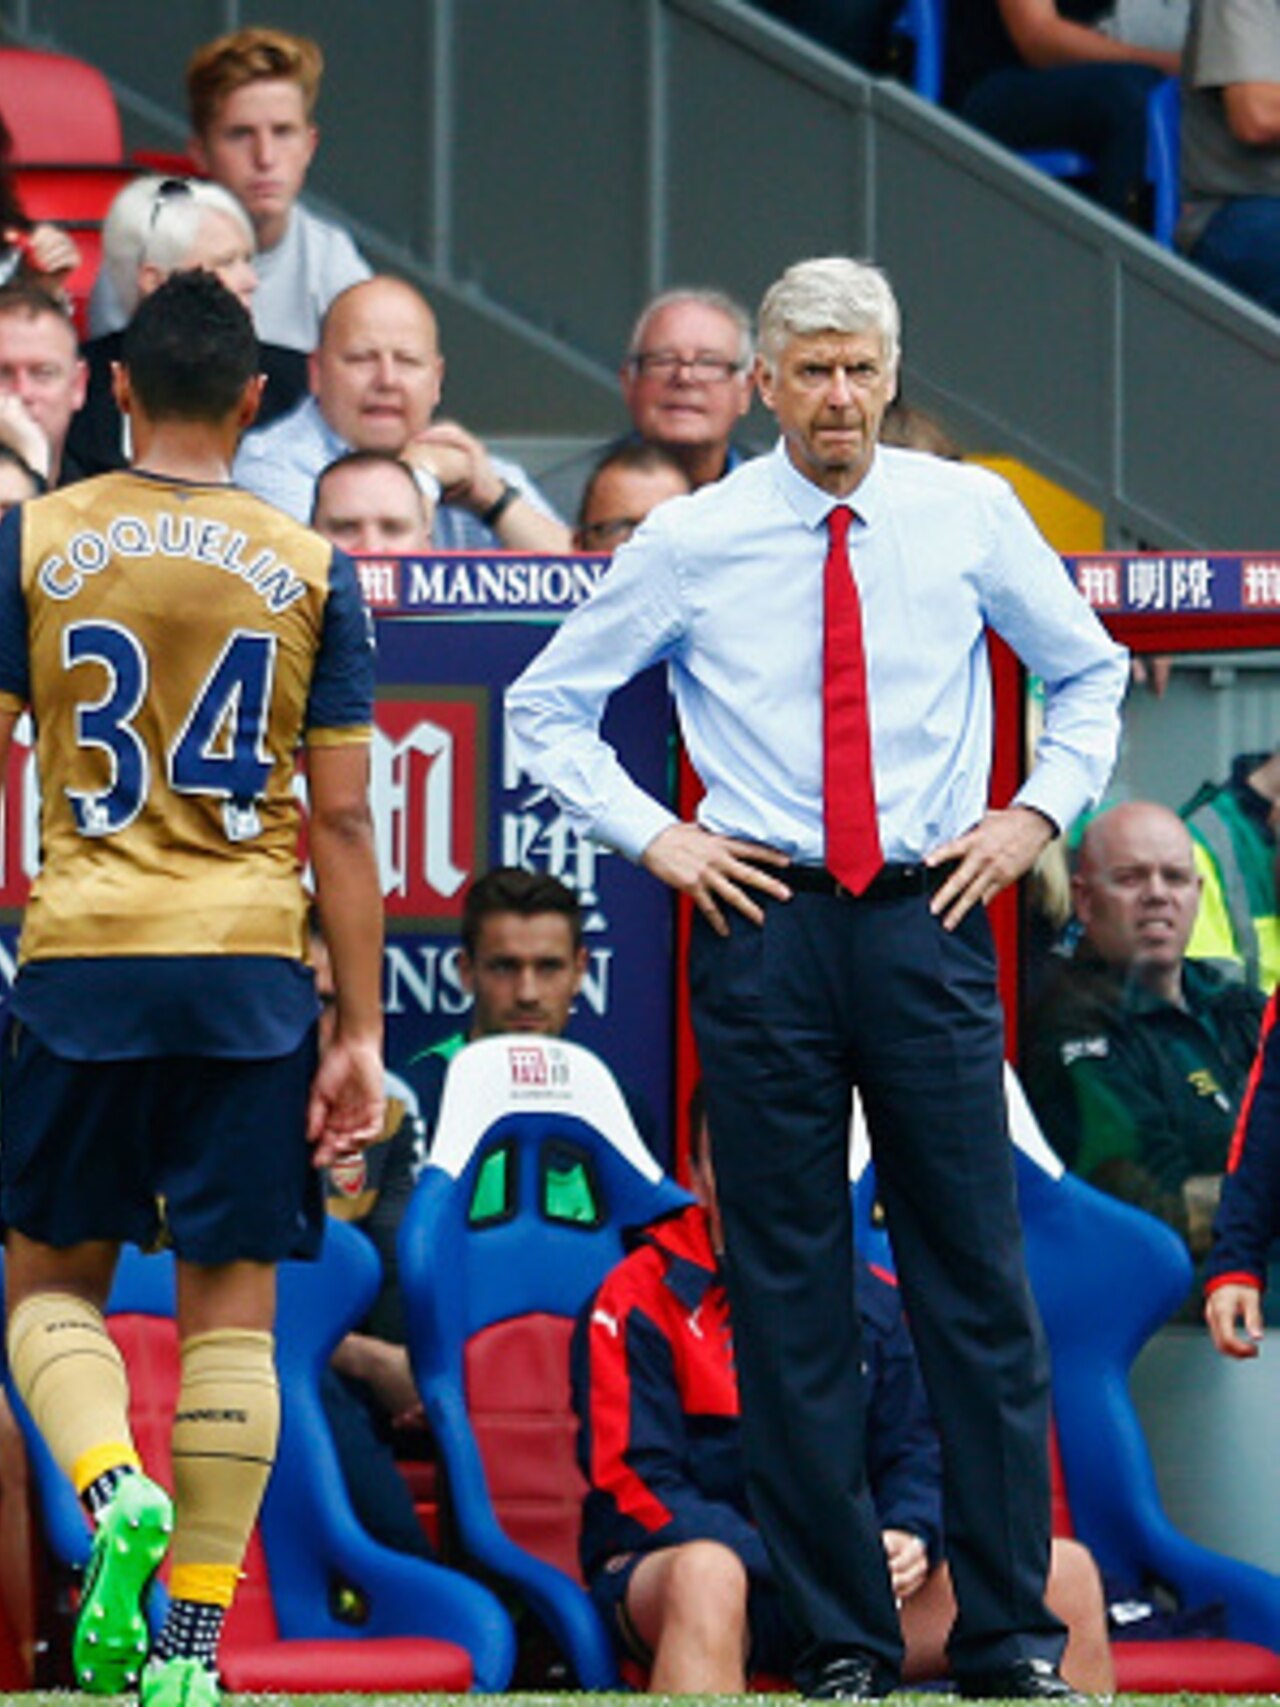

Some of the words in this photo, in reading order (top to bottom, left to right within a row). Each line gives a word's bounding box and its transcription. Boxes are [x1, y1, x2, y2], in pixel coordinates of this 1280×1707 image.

[37, 512, 307, 614] COQUELIN
[408, 562, 604, 605] MANSION
[61, 617, 278, 842] 34
